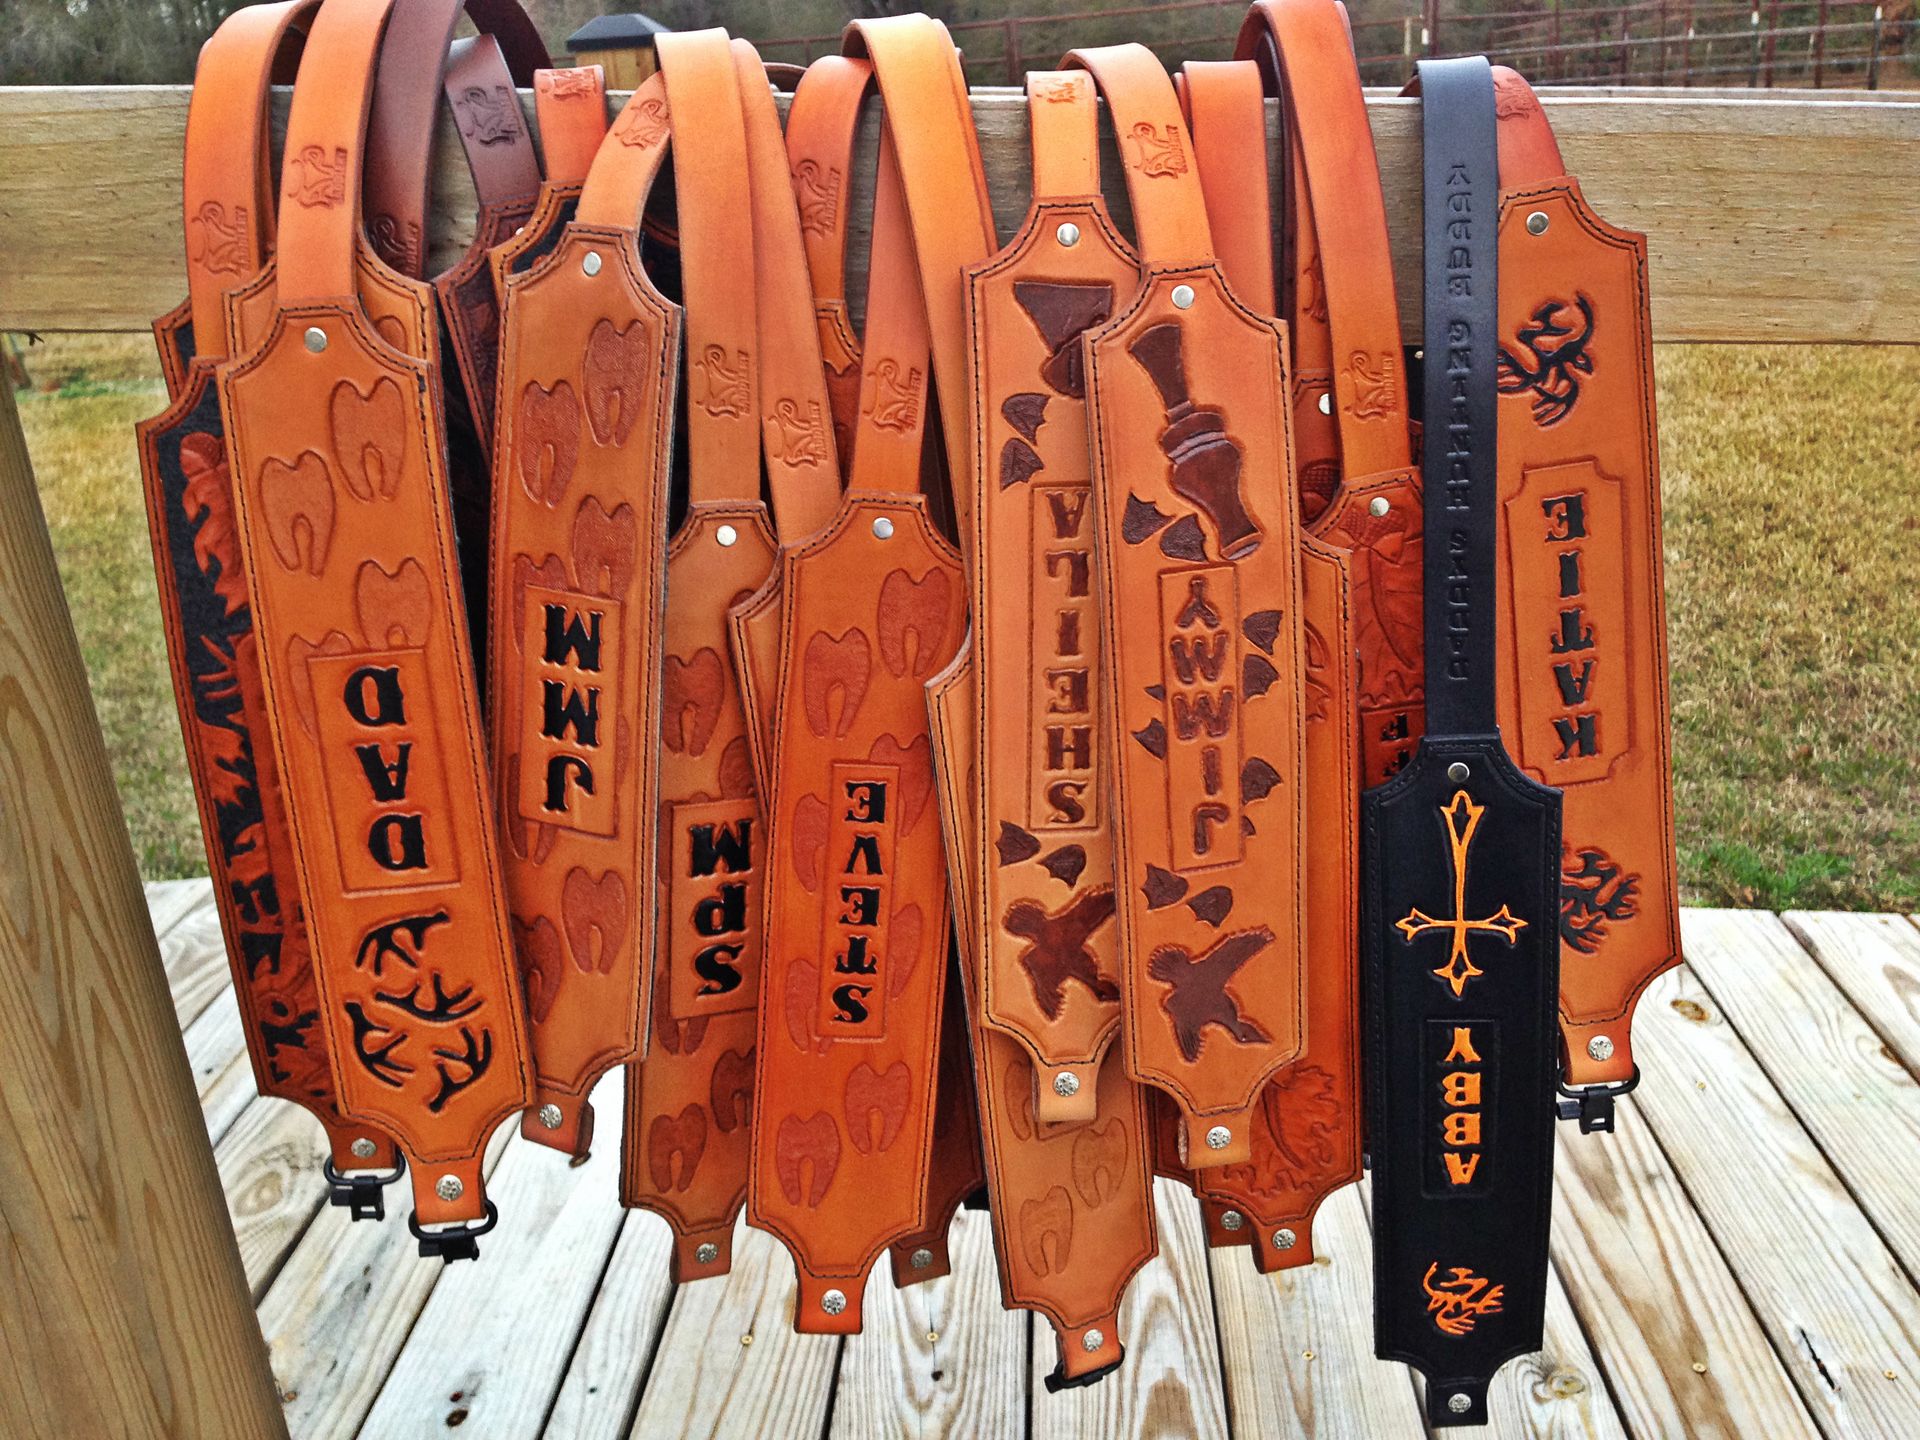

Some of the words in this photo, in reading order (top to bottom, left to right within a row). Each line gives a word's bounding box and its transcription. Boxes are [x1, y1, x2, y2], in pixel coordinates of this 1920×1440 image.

[1445, 164, 1473, 297] BUDDY
[1445, 319, 1472, 513] HUNTING
[541, 603, 603, 814] JMM
[1043, 491, 1092, 825] SHEILA
[1169, 579, 1234, 857] JIMMY
[1541, 490, 1603, 760] KATIE
[342, 665, 431, 871] DAD
[689, 818, 753, 998] SPM
[831, 780, 889, 1025] STEVE
[1439, 1025, 1483, 1187] ABBY
